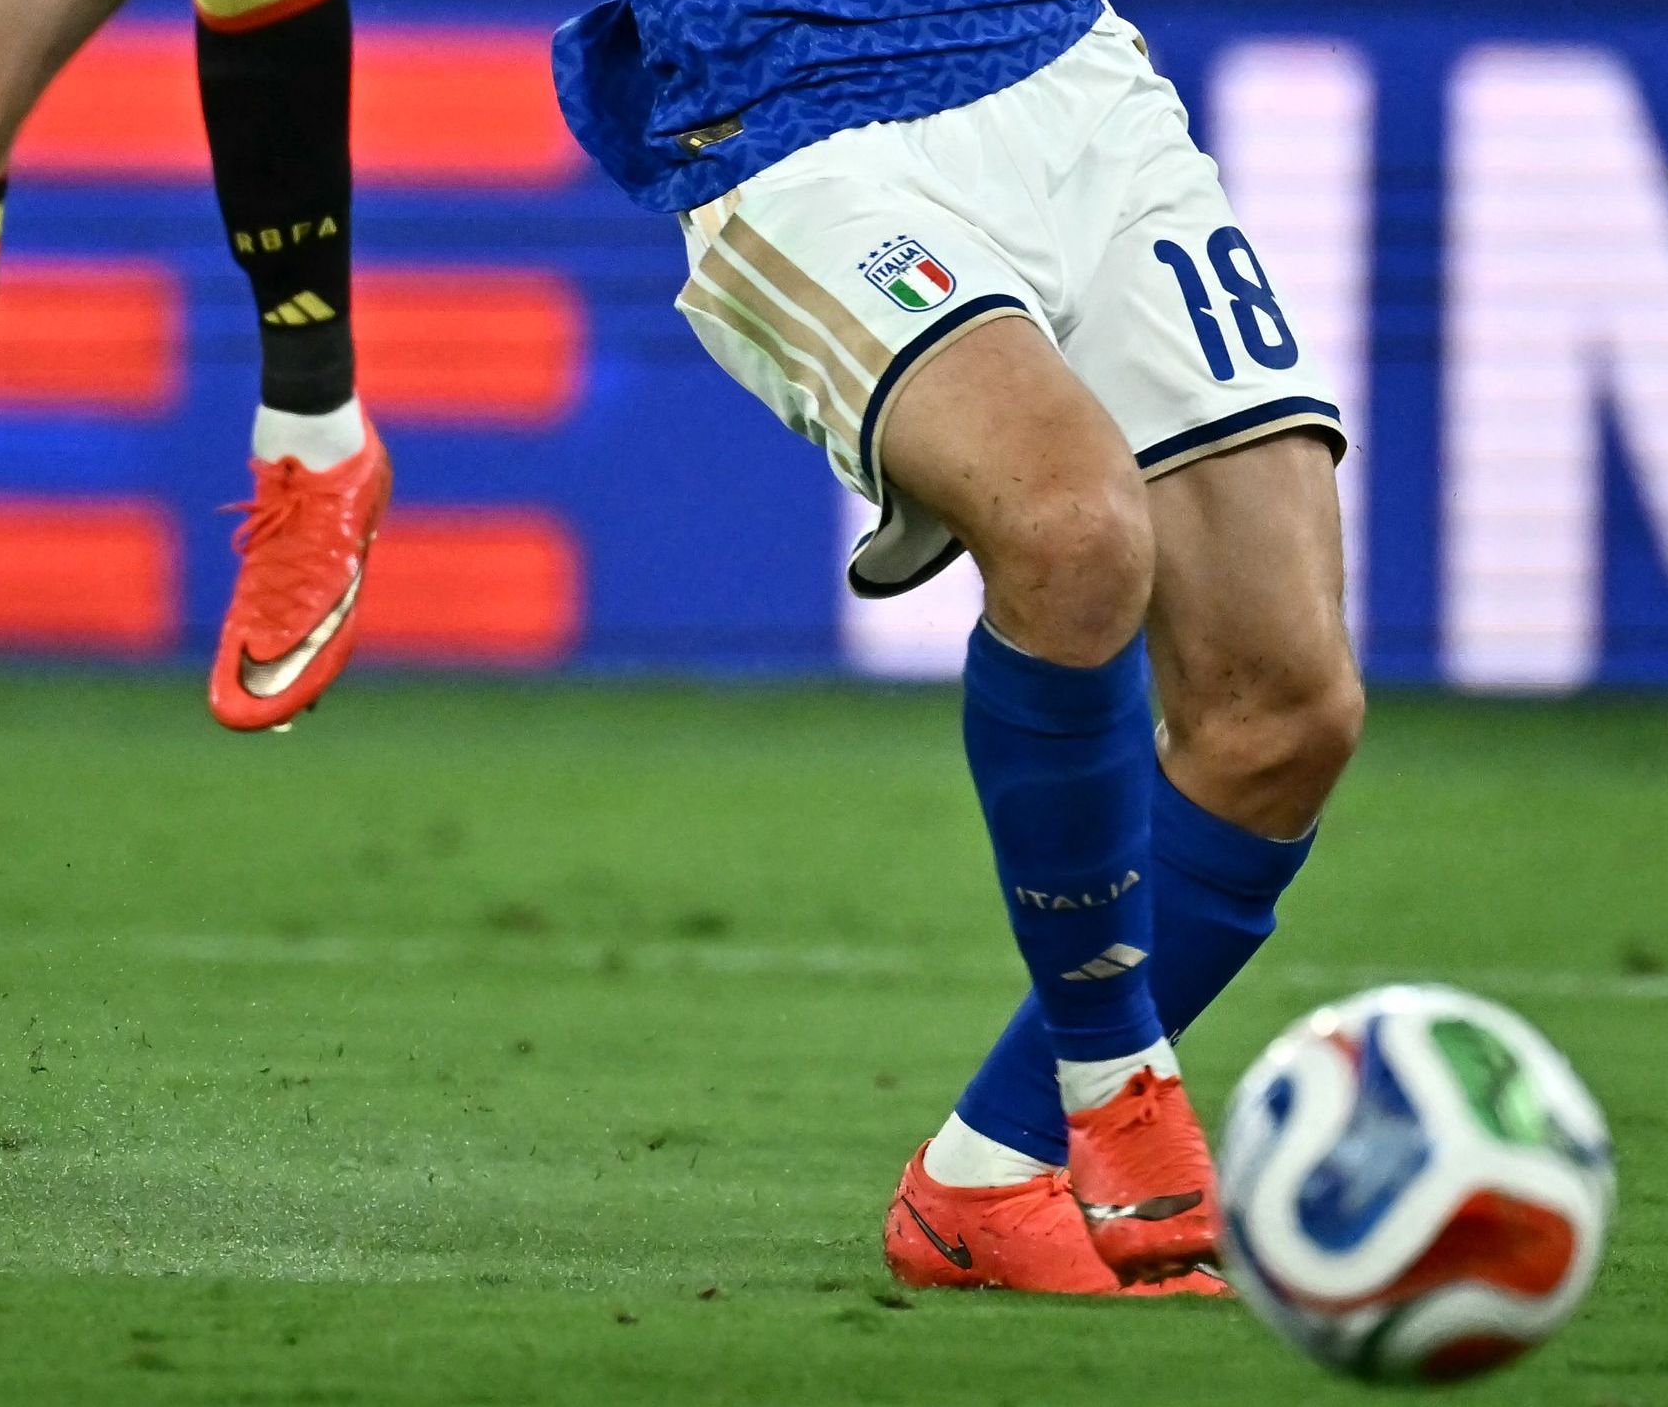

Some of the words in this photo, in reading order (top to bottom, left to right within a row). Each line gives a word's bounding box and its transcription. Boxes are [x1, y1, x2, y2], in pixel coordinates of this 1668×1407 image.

[235, 216, 338, 254] RBFA
[871, 246, 921, 283] ITALIA
[1152, 225, 1299, 382] 18
[1015, 869, 1141, 910] ITALIA
